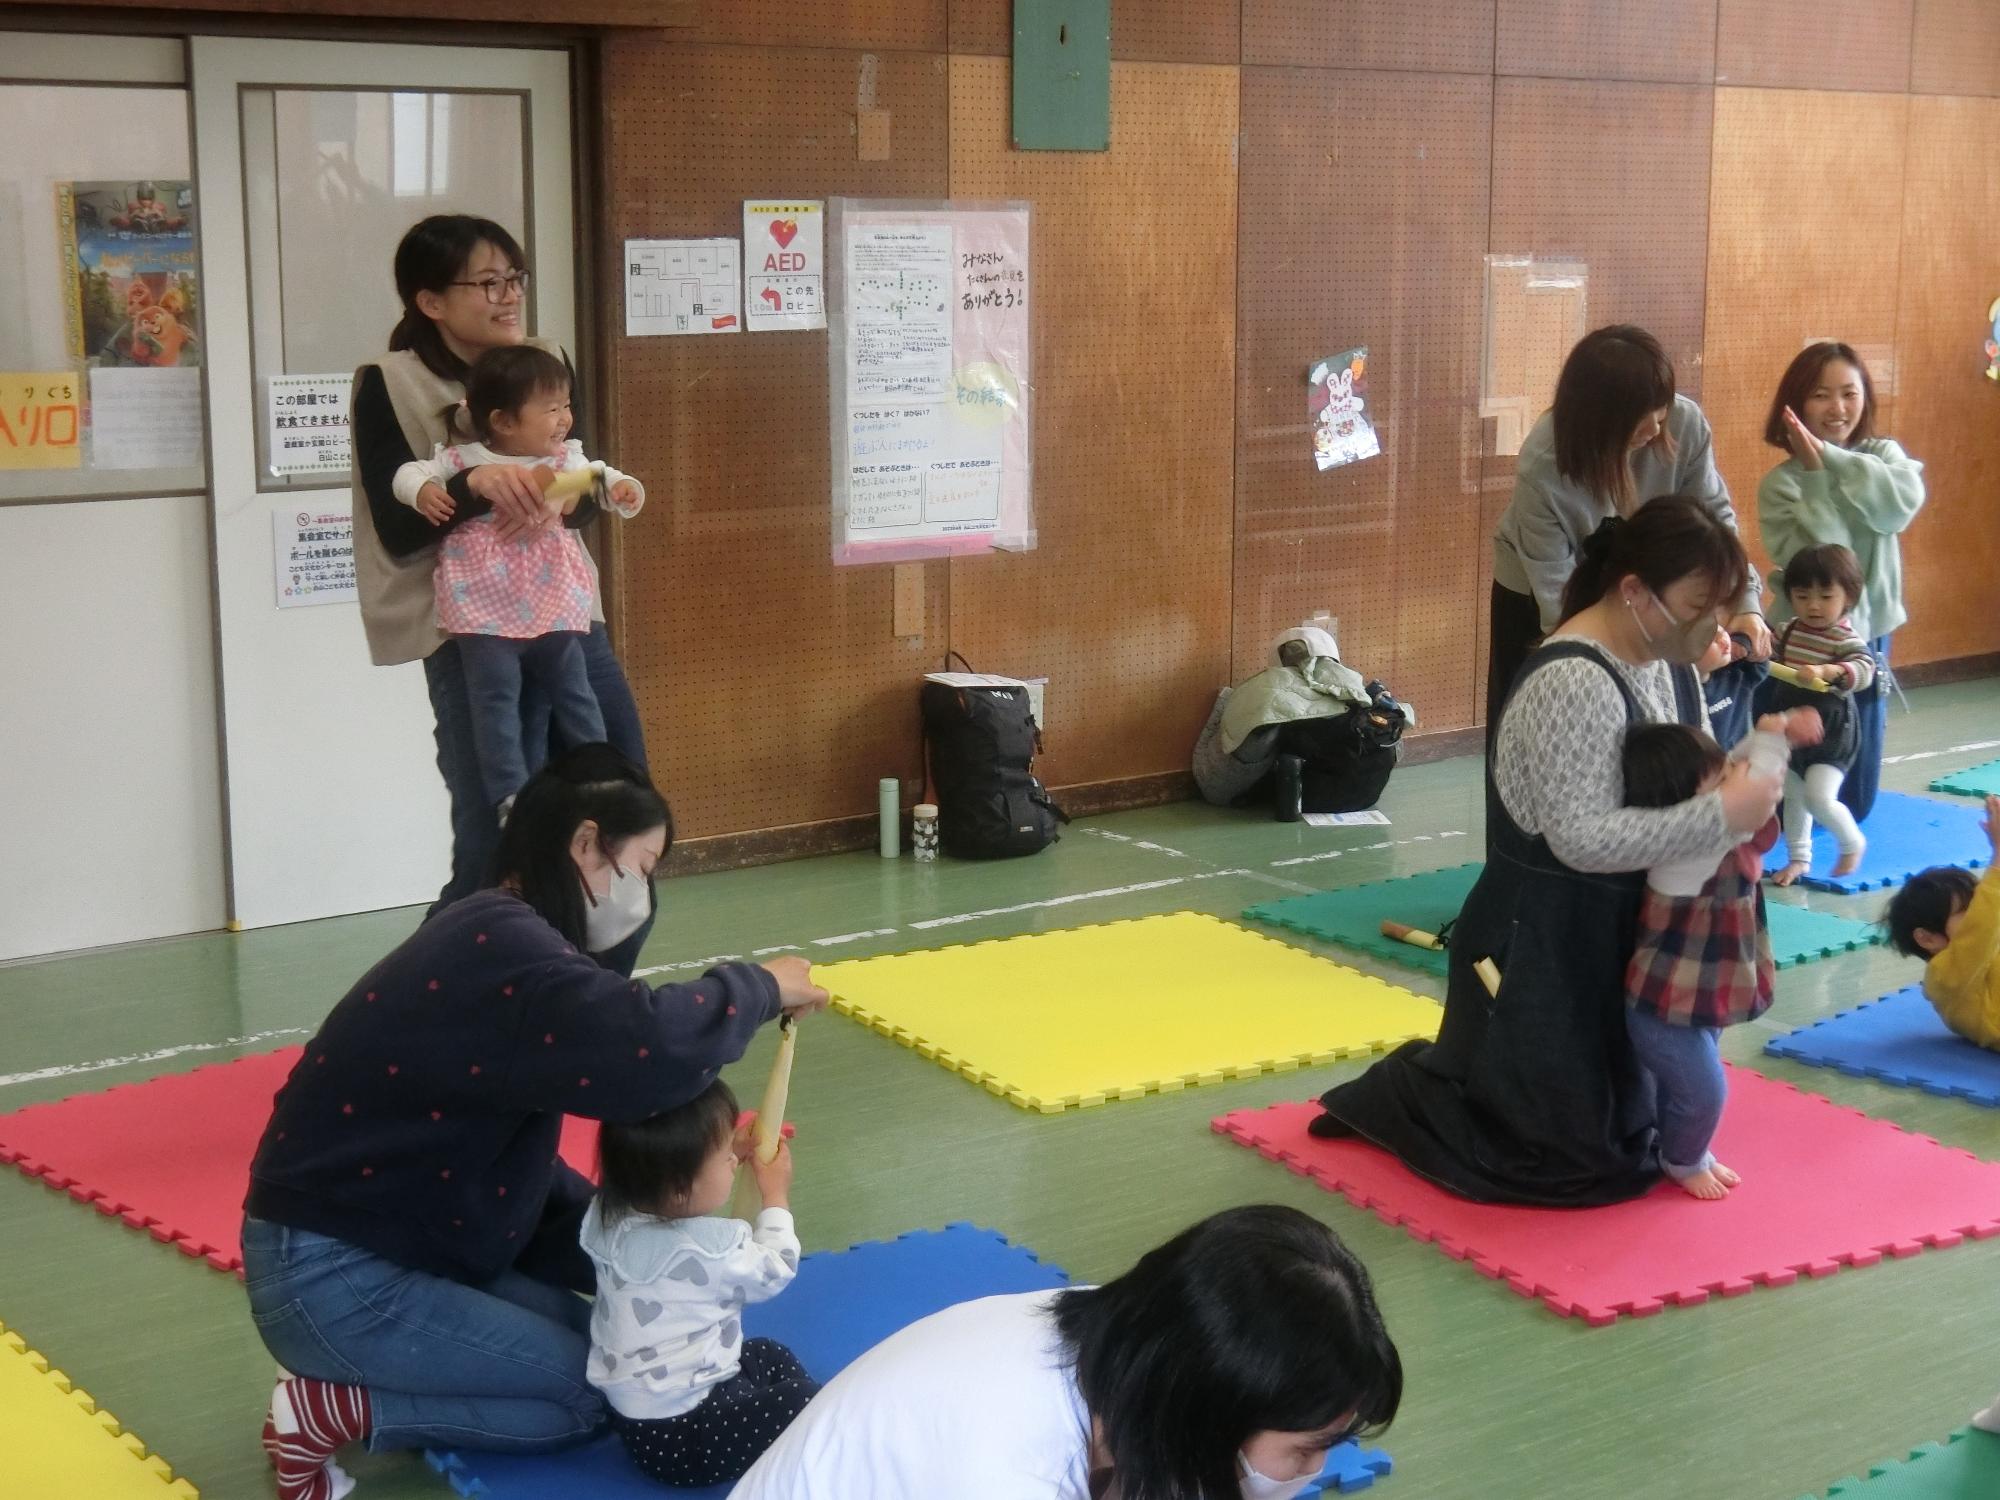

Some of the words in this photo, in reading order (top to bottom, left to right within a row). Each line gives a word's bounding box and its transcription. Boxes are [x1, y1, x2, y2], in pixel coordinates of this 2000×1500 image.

[763, 253, 806, 272] AED
[962, 252, 1003, 267] みなさん
[786, 286, 814, 296] この先
[786, 302, 814, 310] ロビー
[0, 386, 72, 399] りぐち
[276, 394, 339, 406] この部屋では
